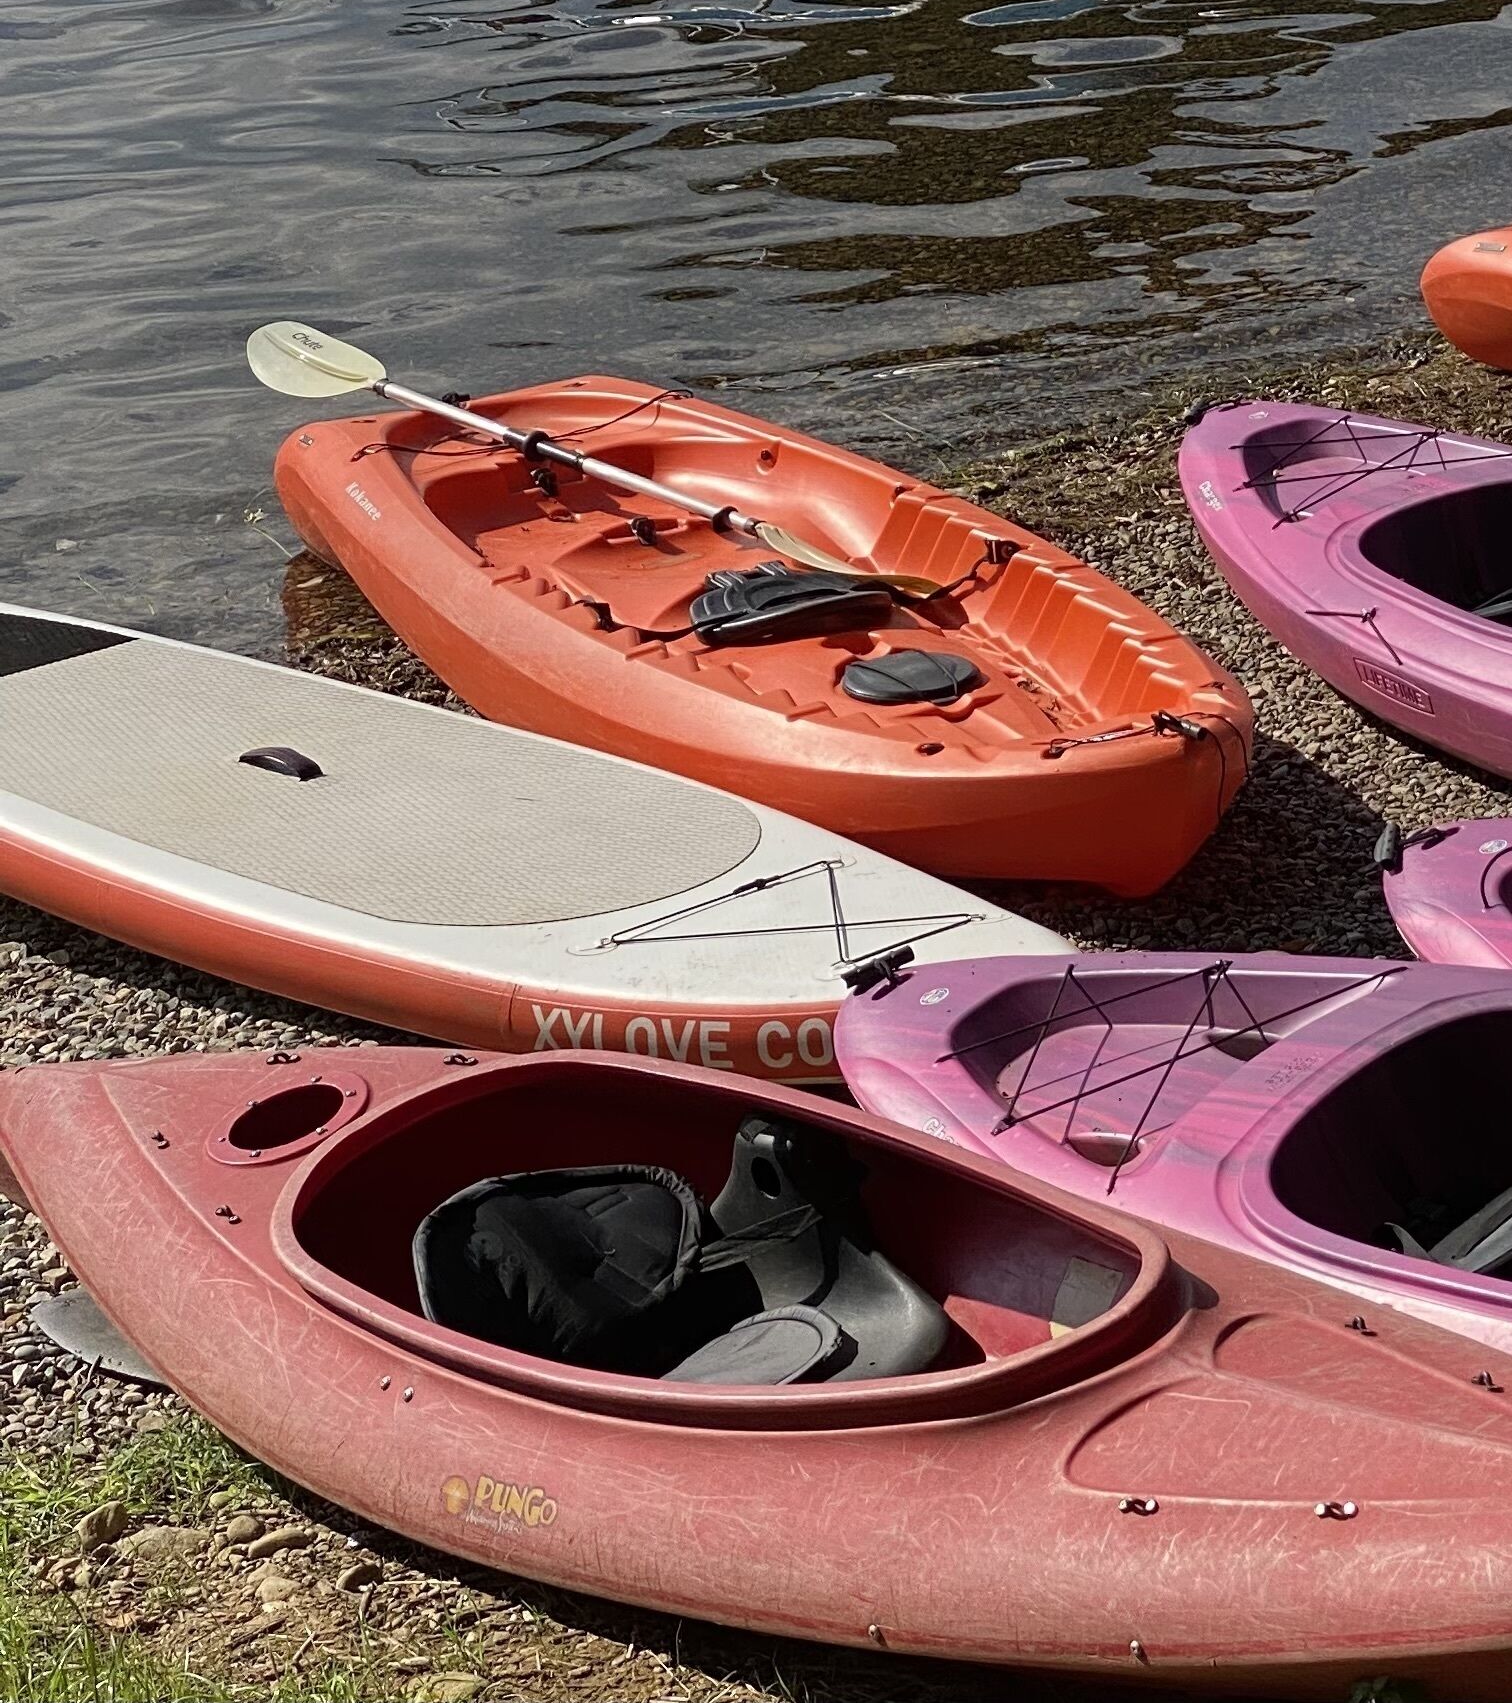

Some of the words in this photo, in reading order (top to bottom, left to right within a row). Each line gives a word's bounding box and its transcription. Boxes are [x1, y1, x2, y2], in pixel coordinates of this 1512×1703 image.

[345, 481, 382, 521] Kokanee
[1361, 664, 1427, 709] LIFETIME
[757, 1017, 834, 1069] CO
[475, 1475, 558, 1528] PUNGO
